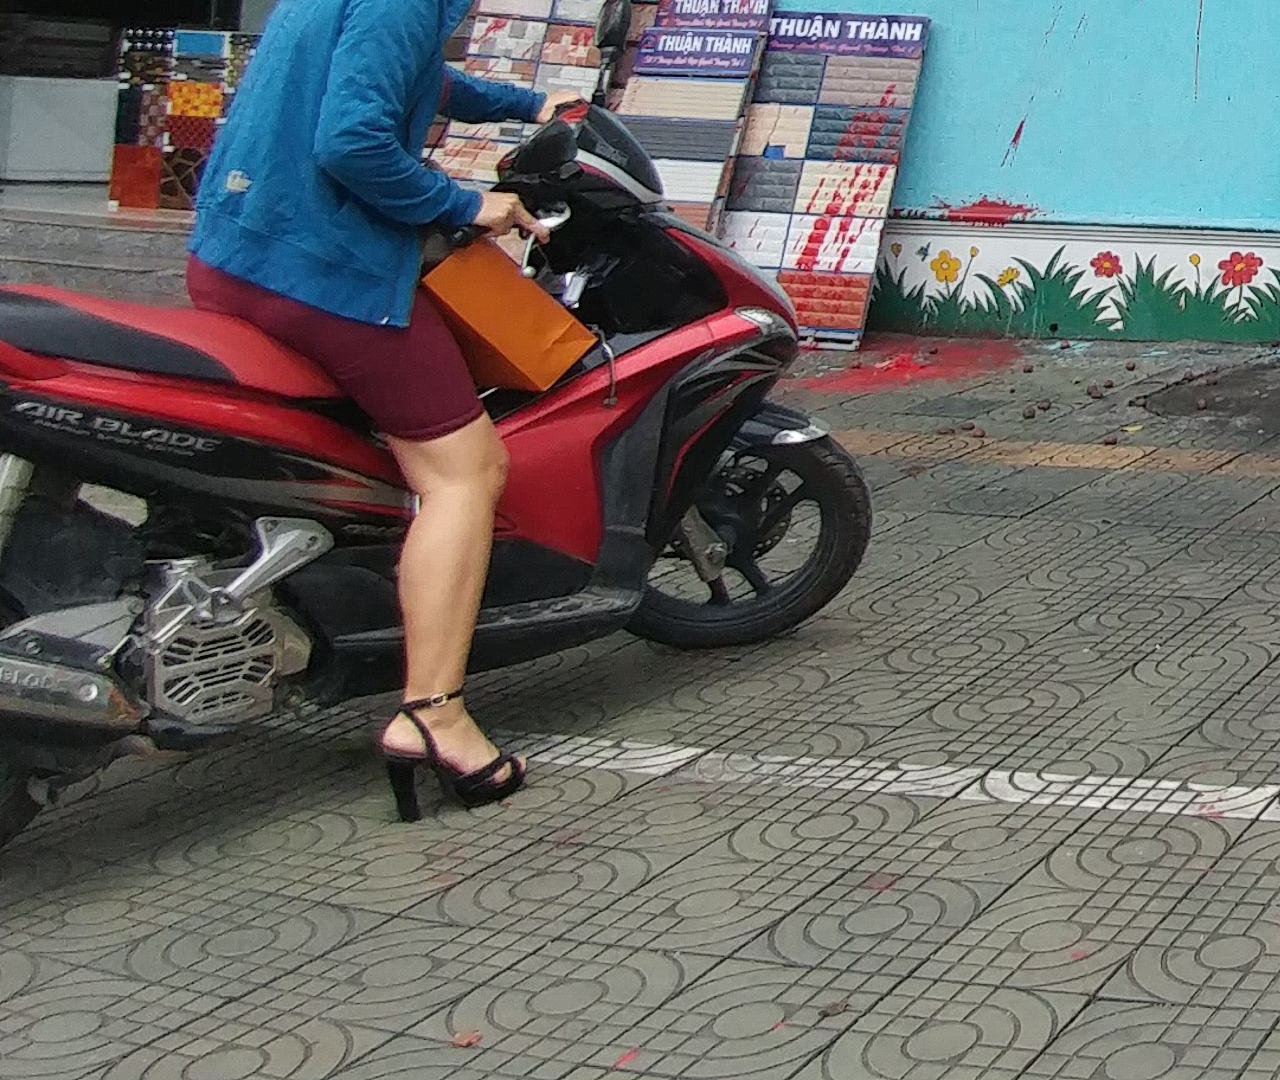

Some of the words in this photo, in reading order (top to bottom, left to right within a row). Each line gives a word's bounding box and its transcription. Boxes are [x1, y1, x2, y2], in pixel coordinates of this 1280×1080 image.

[769, 16, 840, 42] THUẬN
[847, 18, 923, 41] THÀNH
[658, 32, 702, 54] THUẬN
[705, 32, 752, 54] THÀNH
[13, 401, 84, 425] AIR
[90, 417, 223, 452] BLADE
